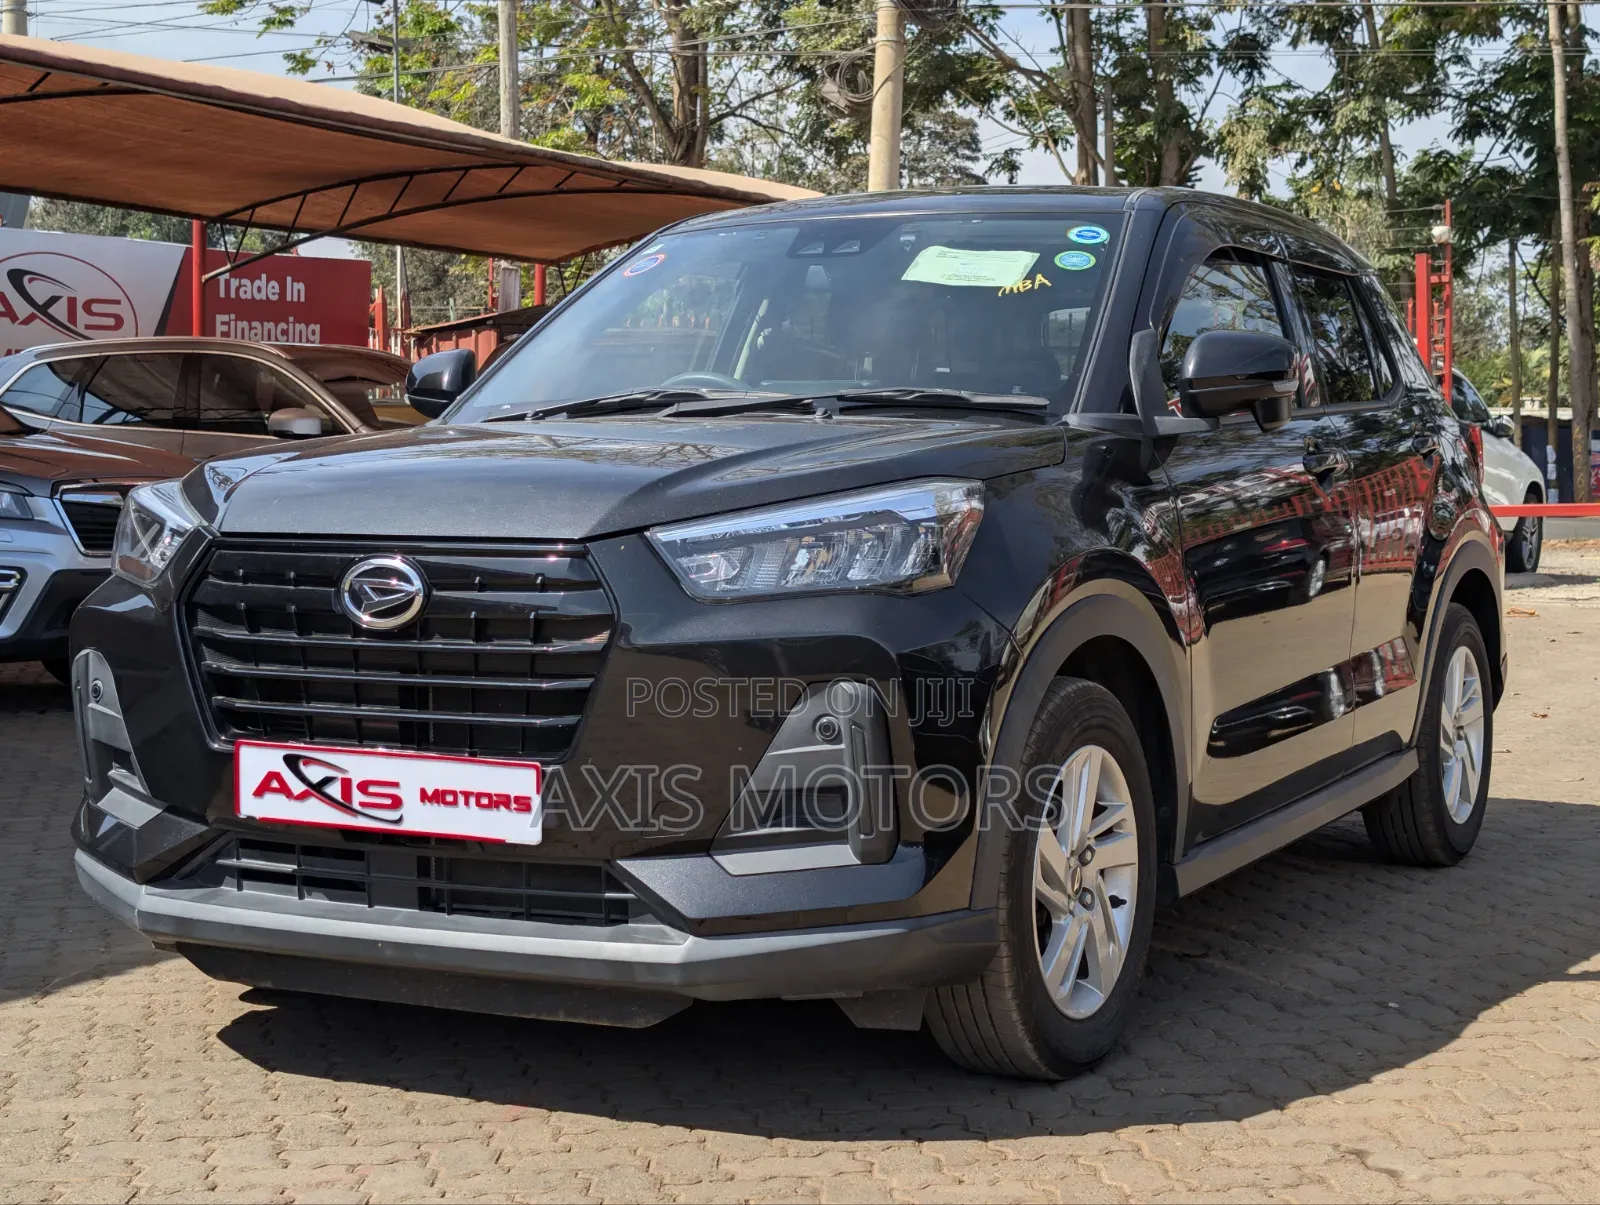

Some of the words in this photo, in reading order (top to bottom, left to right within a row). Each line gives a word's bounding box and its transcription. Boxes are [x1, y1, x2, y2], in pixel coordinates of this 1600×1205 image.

[217, 272, 280, 301] Trade
[286, 275, 306, 302] In
[215, 313, 321, 344] Financing
[252, 753, 404, 824] AXIS
[419, 786, 532, 813] MOTORS
